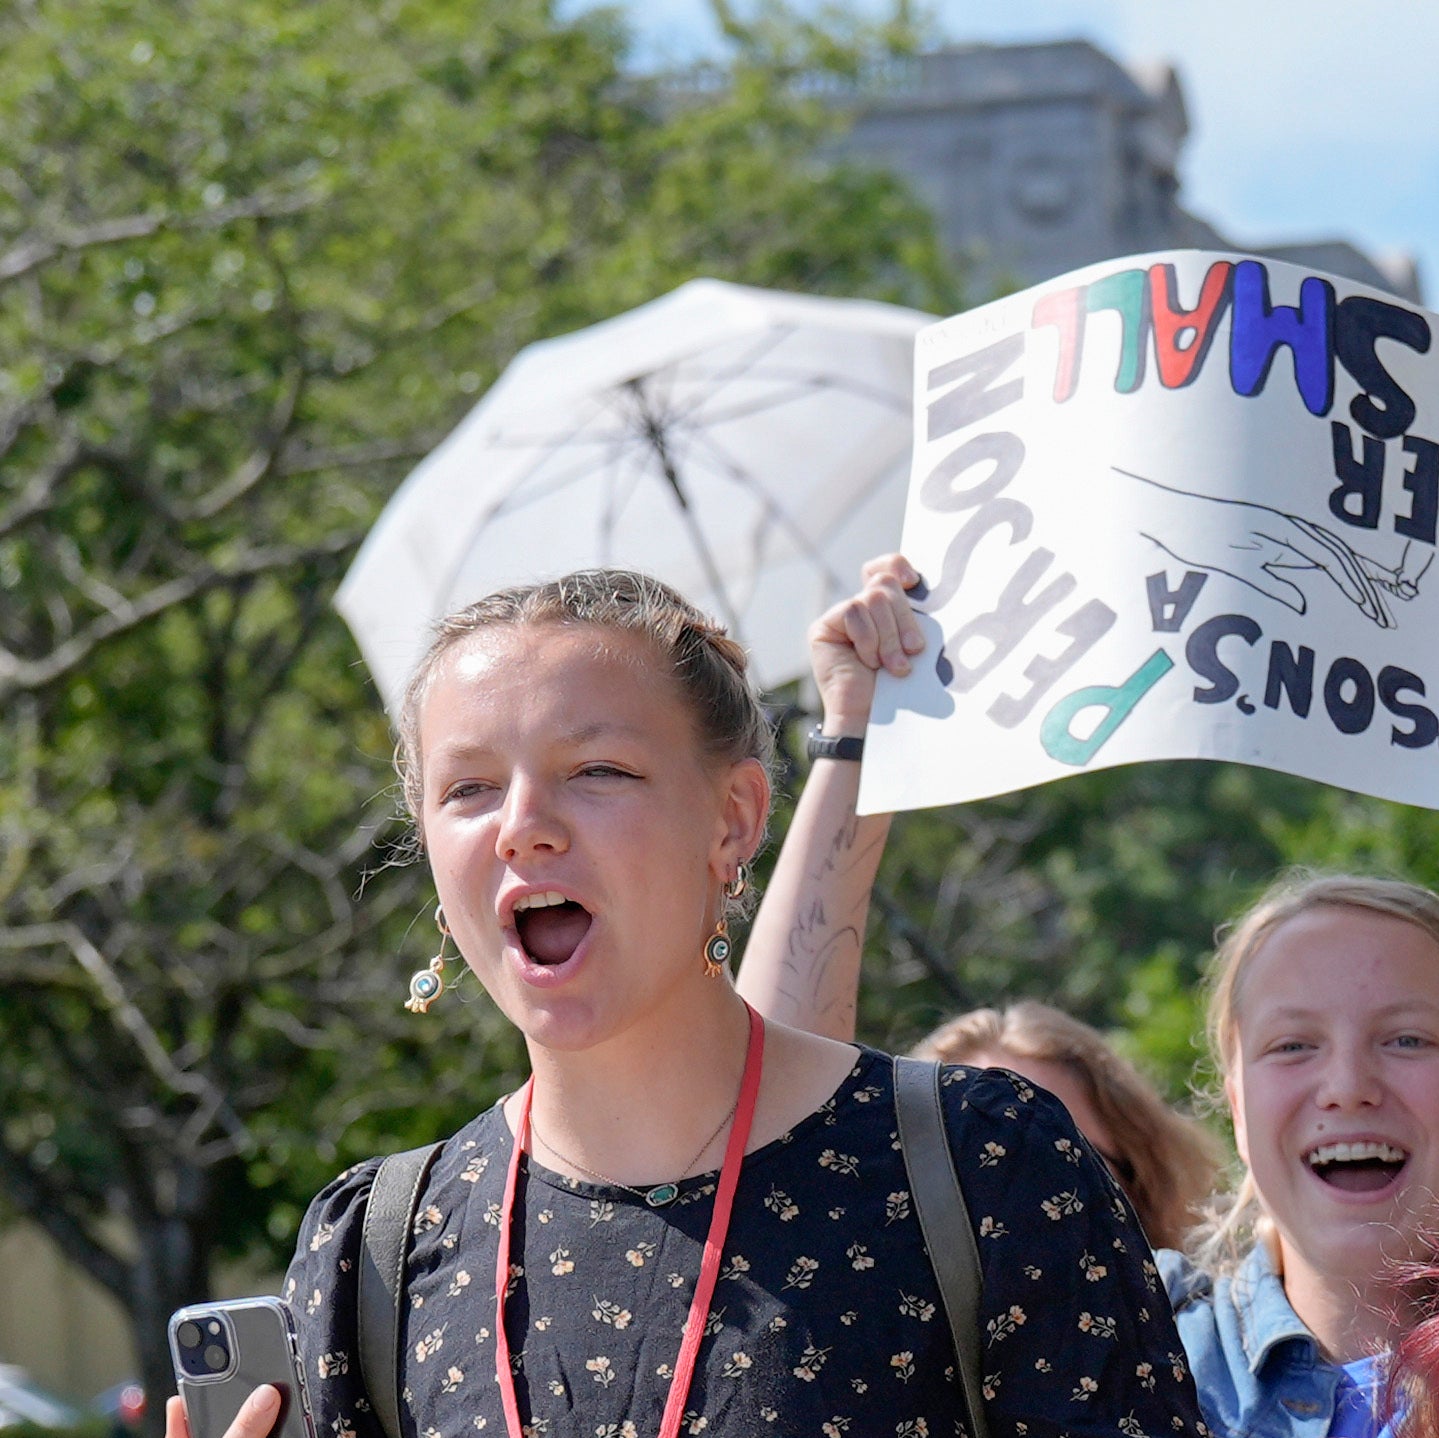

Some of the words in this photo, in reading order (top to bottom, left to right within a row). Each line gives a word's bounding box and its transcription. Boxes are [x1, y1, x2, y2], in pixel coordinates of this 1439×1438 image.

[1031, 260, 1431, 439] SMALL
[915, 332, 1175, 767] PERSON
[1146, 571, 1207, 634] A
